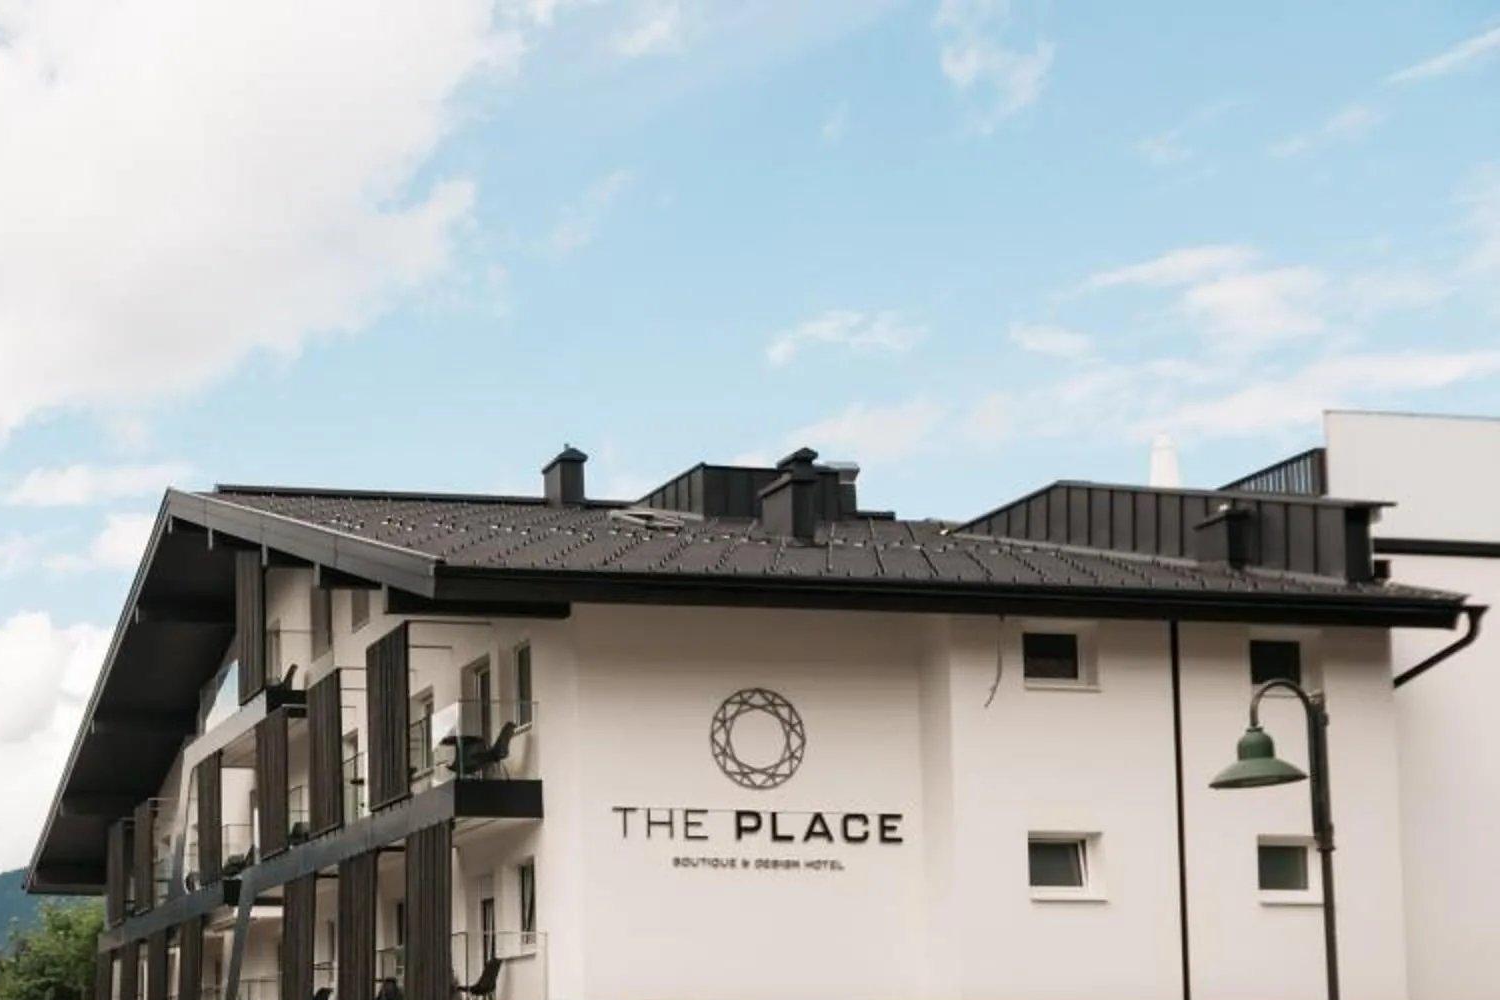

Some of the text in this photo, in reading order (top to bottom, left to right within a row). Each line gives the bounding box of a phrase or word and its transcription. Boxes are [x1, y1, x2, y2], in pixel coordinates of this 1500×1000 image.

[612, 806, 903, 843] THE PLACE
[672, 856, 737, 868] BOUTIQUE
[755, 858, 800, 870] DESIGN
[804, 859, 845, 871] HOTEL
